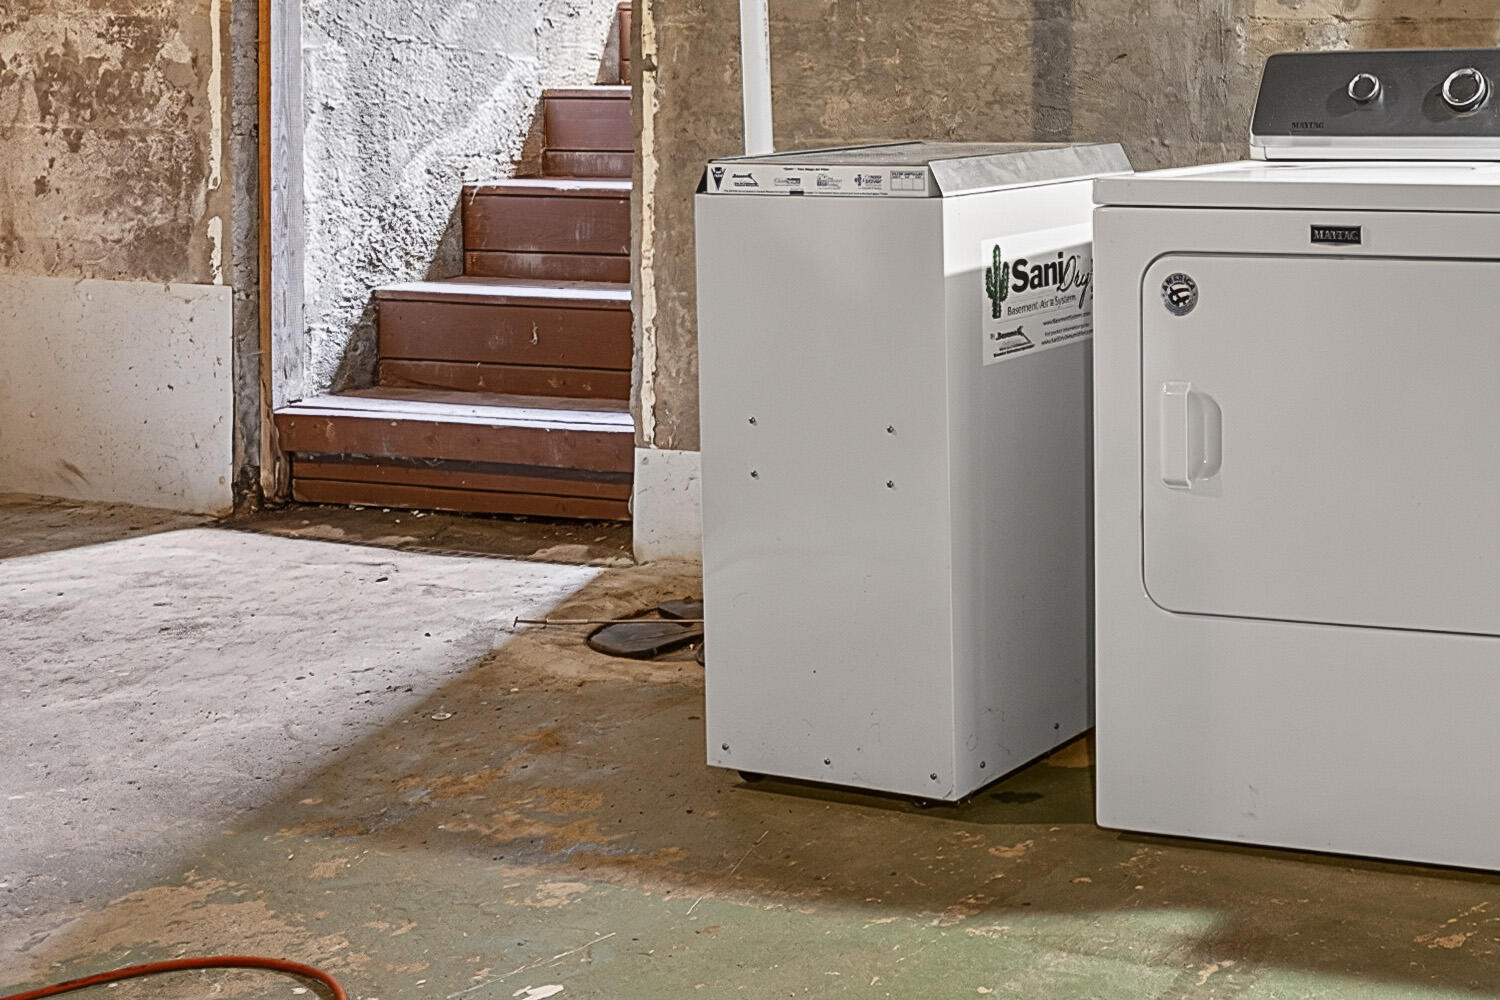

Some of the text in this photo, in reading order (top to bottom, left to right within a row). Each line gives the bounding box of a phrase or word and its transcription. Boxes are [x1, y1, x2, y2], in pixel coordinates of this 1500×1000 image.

[1291, 121, 1324, 129] MAYTAG
[1313, 229, 1358, 241] MAYTAG
[1007, 294, 1076, 317] Basement Air System
